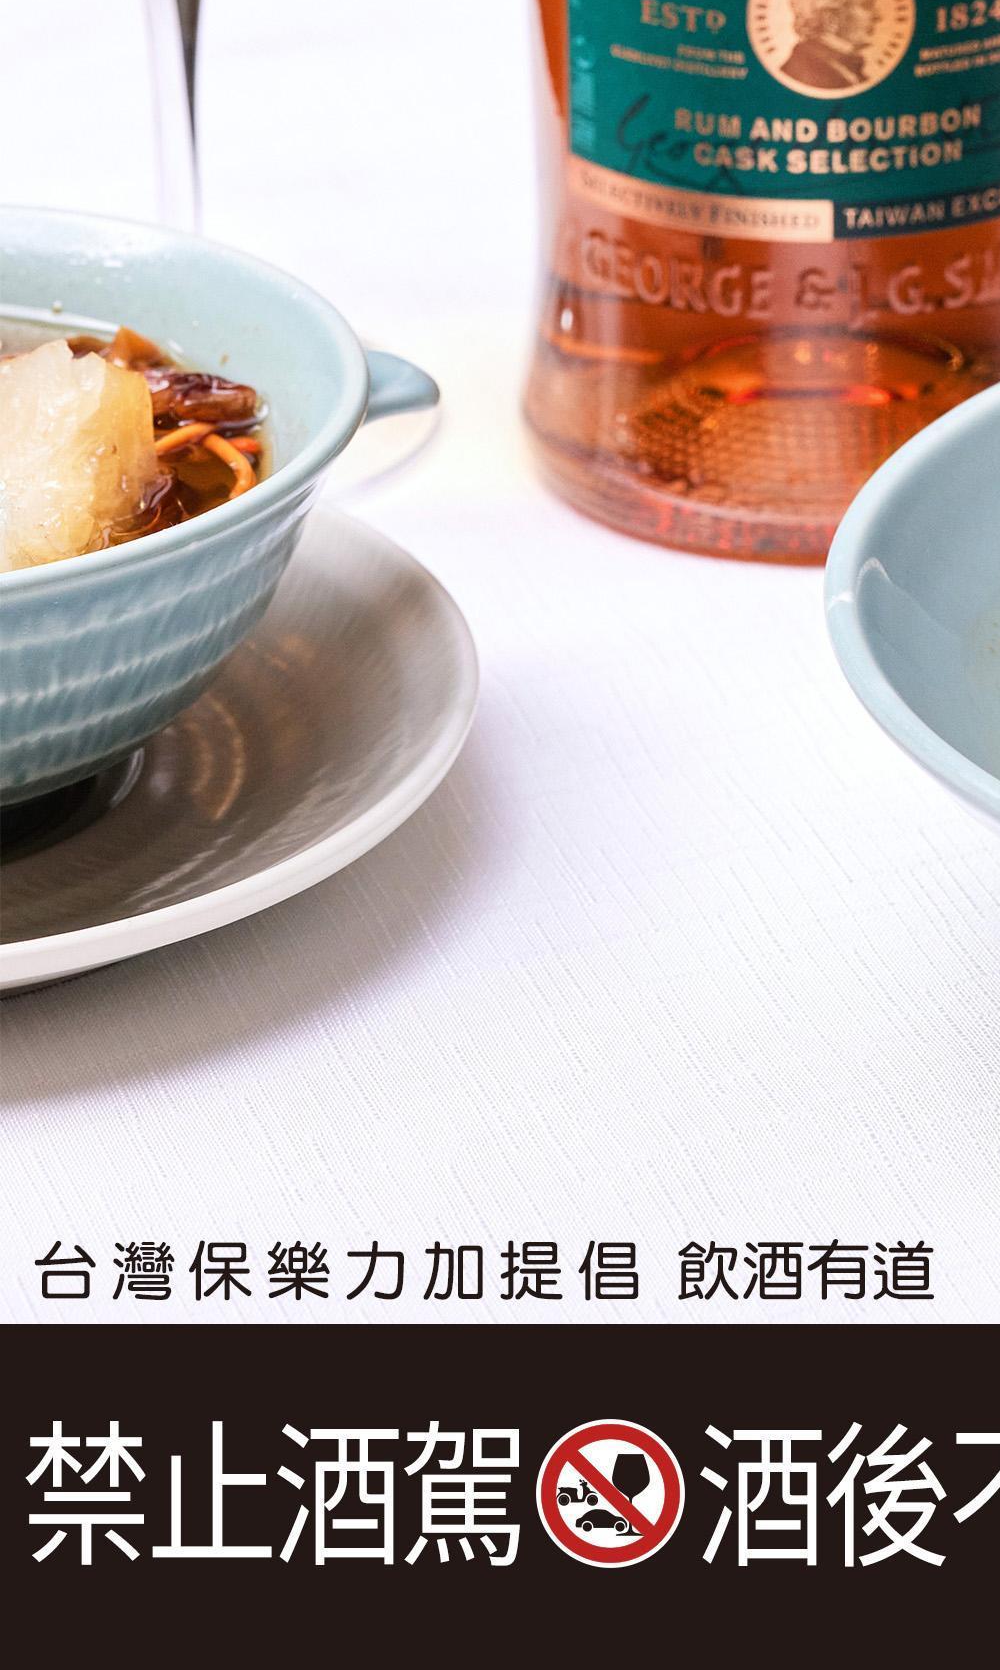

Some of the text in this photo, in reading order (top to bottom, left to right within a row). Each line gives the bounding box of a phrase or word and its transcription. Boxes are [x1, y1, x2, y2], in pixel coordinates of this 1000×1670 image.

[674, 103, 982, 143] RUM AND BOURBON
[694, 137, 963, 175] CASK SELECTION
[843, 199, 945, 229] TAIWAN
